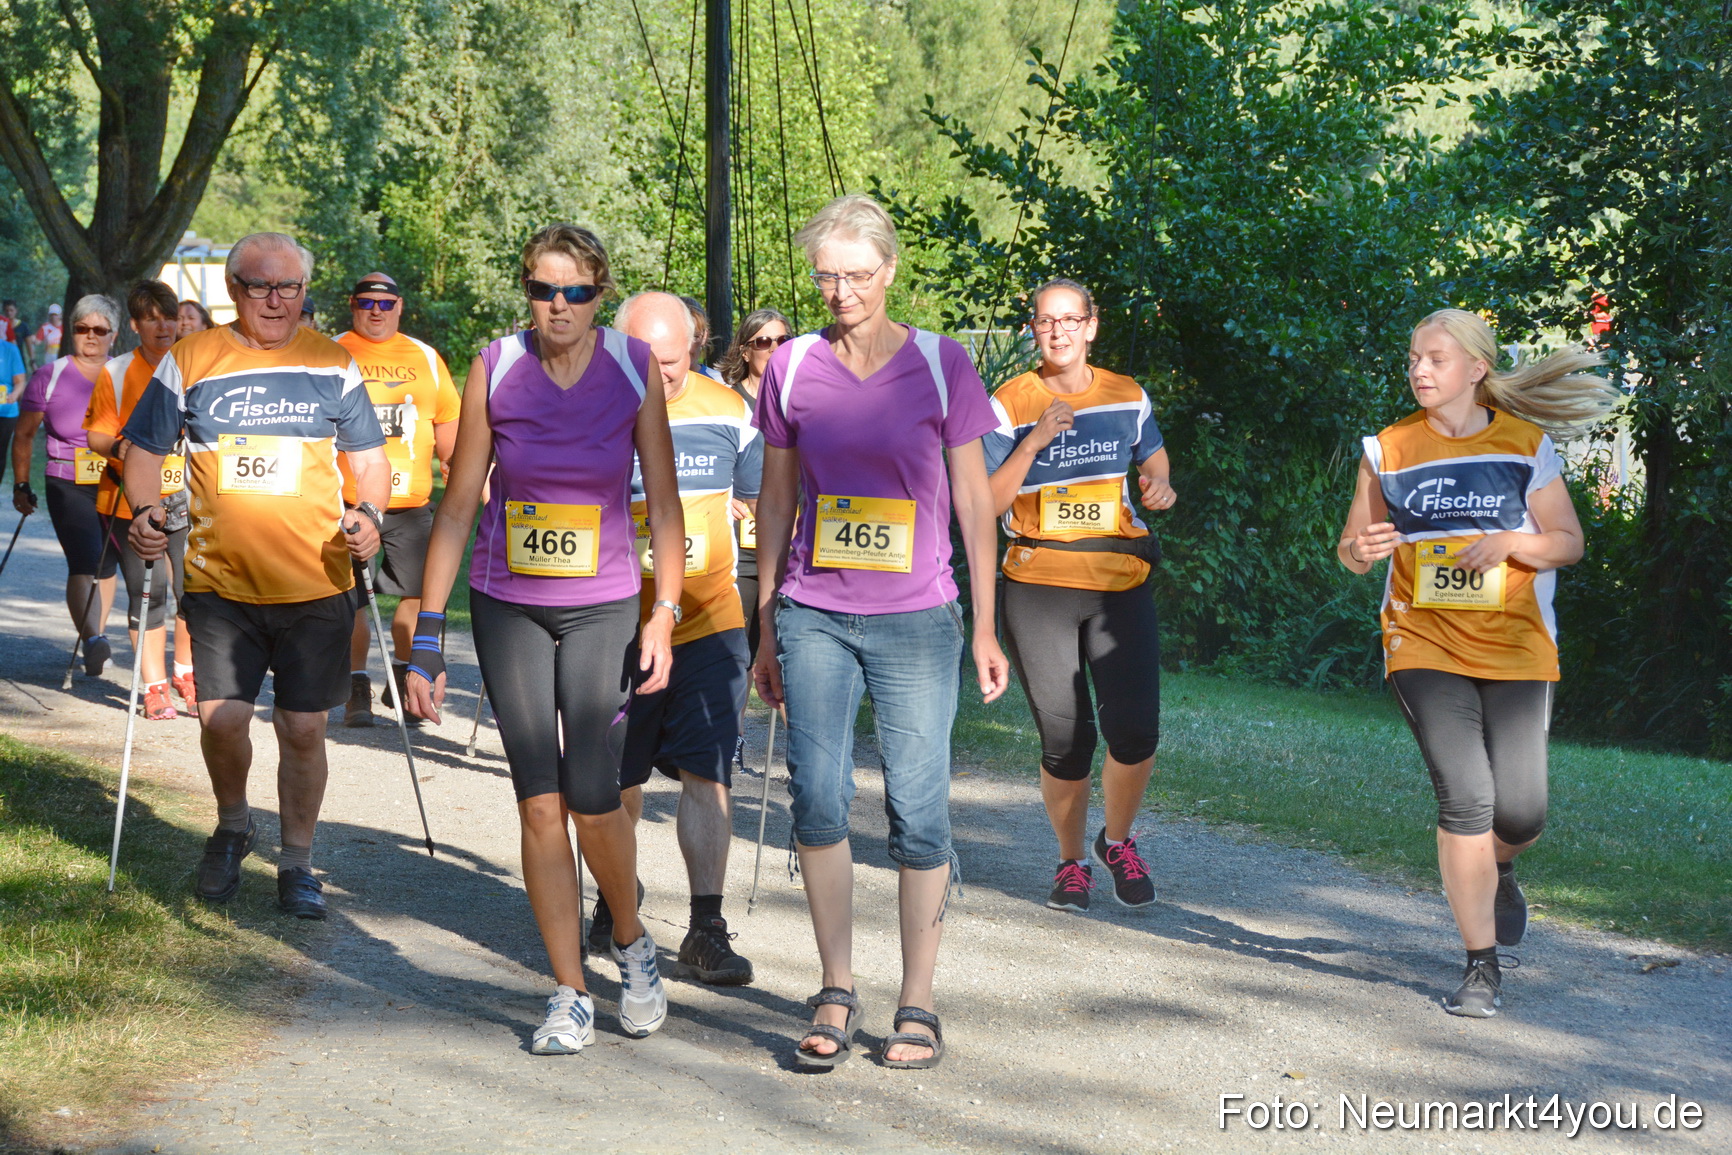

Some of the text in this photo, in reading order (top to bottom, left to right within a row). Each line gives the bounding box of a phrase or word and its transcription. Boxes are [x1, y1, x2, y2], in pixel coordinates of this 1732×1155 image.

[357, 365, 417, 381] WINGS
[229, 398, 320, 418] Fischer
[238, 416, 314, 426] AUTOMOBILE
[1049, 438, 1120, 462] Fischer
[236, 456, 278, 478] 564
[1058, 454, 1118, 468] AUTOMOBILE
[1058, 502, 1100, 520] 588
[1422, 491, 1506, 512] Fischer
[1430, 510, 1499, 520] AUTOMOBILE
[523, 529, 577, 556] 466
[834, 522, 891, 550] 465
[529, 555, 551, 563] Müller
[820, 547, 887, 558] Wünnenberg-Pfeufer
[1434, 566, 1484, 590] 590
